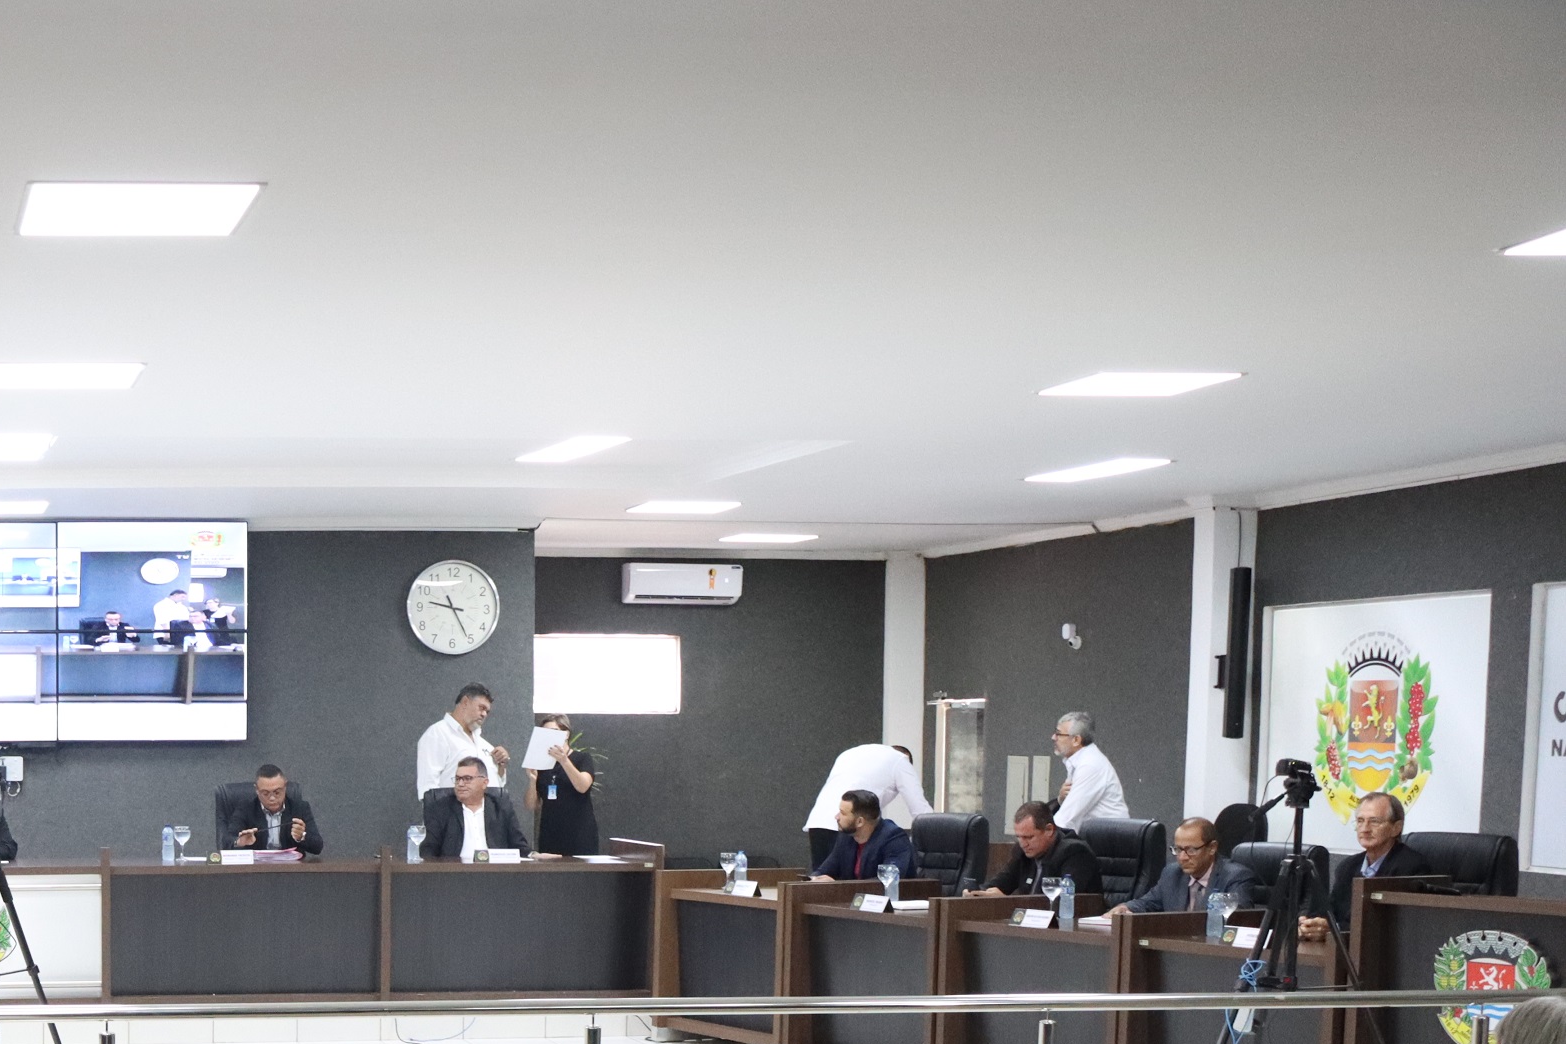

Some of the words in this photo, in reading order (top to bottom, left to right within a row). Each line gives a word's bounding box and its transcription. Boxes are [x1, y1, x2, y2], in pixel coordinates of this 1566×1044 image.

[447, 567, 460, 577] 12
[429, 573, 440, 582] 11
[469, 573, 473, 583] 1
[418, 585, 431, 595] 10
[479, 587, 486, 597] 2
[417, 602, 424, 612] 9
[483, 605, 490, 614] 3
[419, 621, 426, 631] 8
[479, 623, 486, 632] 4
[431, 634, 438, 643] 7
[449, 639, 456, 648] 6
[467, 634, 474, 644] 5
[1403, 784, 1420, 807] 1979
